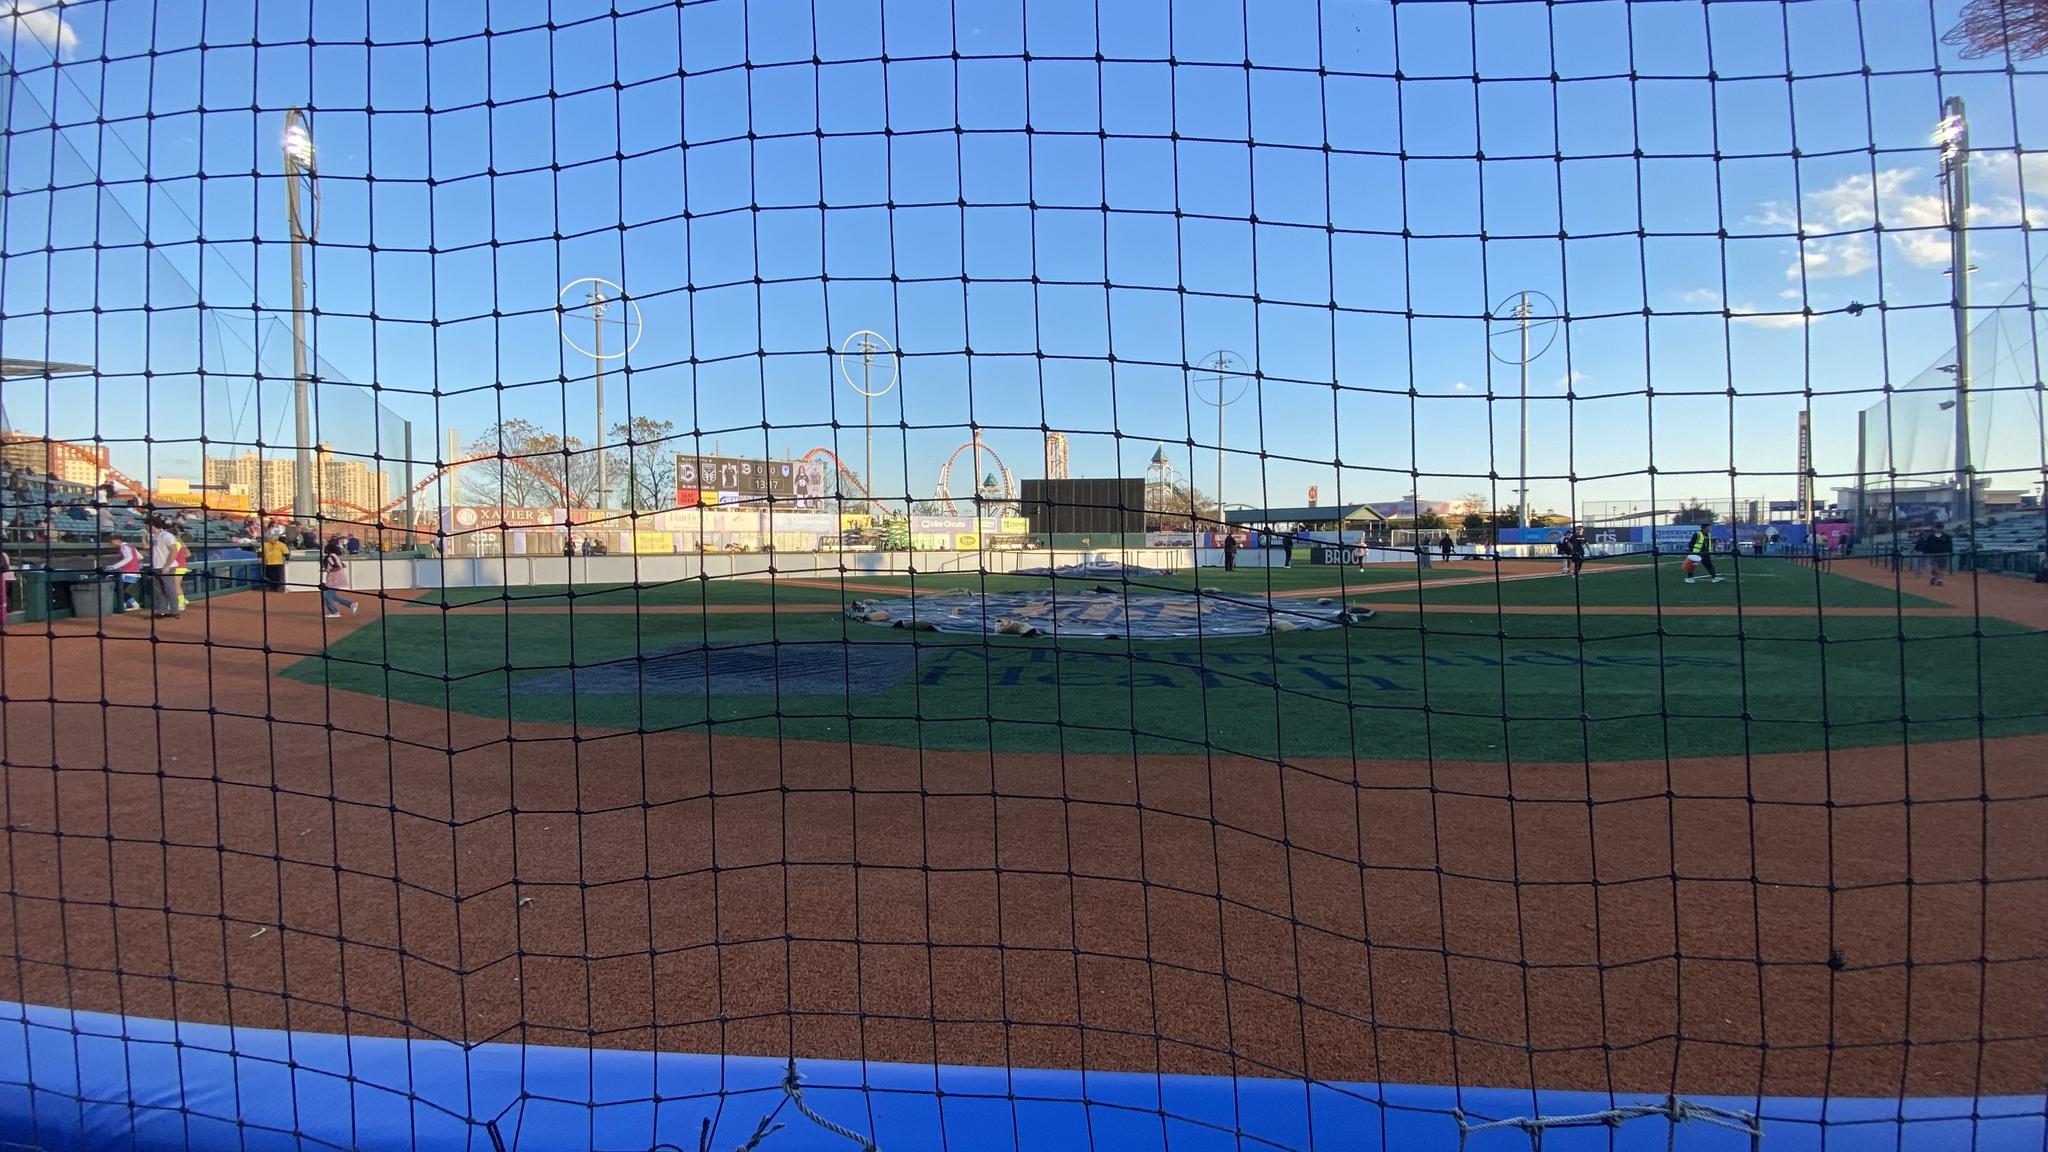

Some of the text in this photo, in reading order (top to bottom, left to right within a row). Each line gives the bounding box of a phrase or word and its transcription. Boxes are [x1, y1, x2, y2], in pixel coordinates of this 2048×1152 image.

[481, 509, 534, 520] XAVIER
[1595, 531, 1617, 543] rts
[919, 666, 1416, 688] Health
